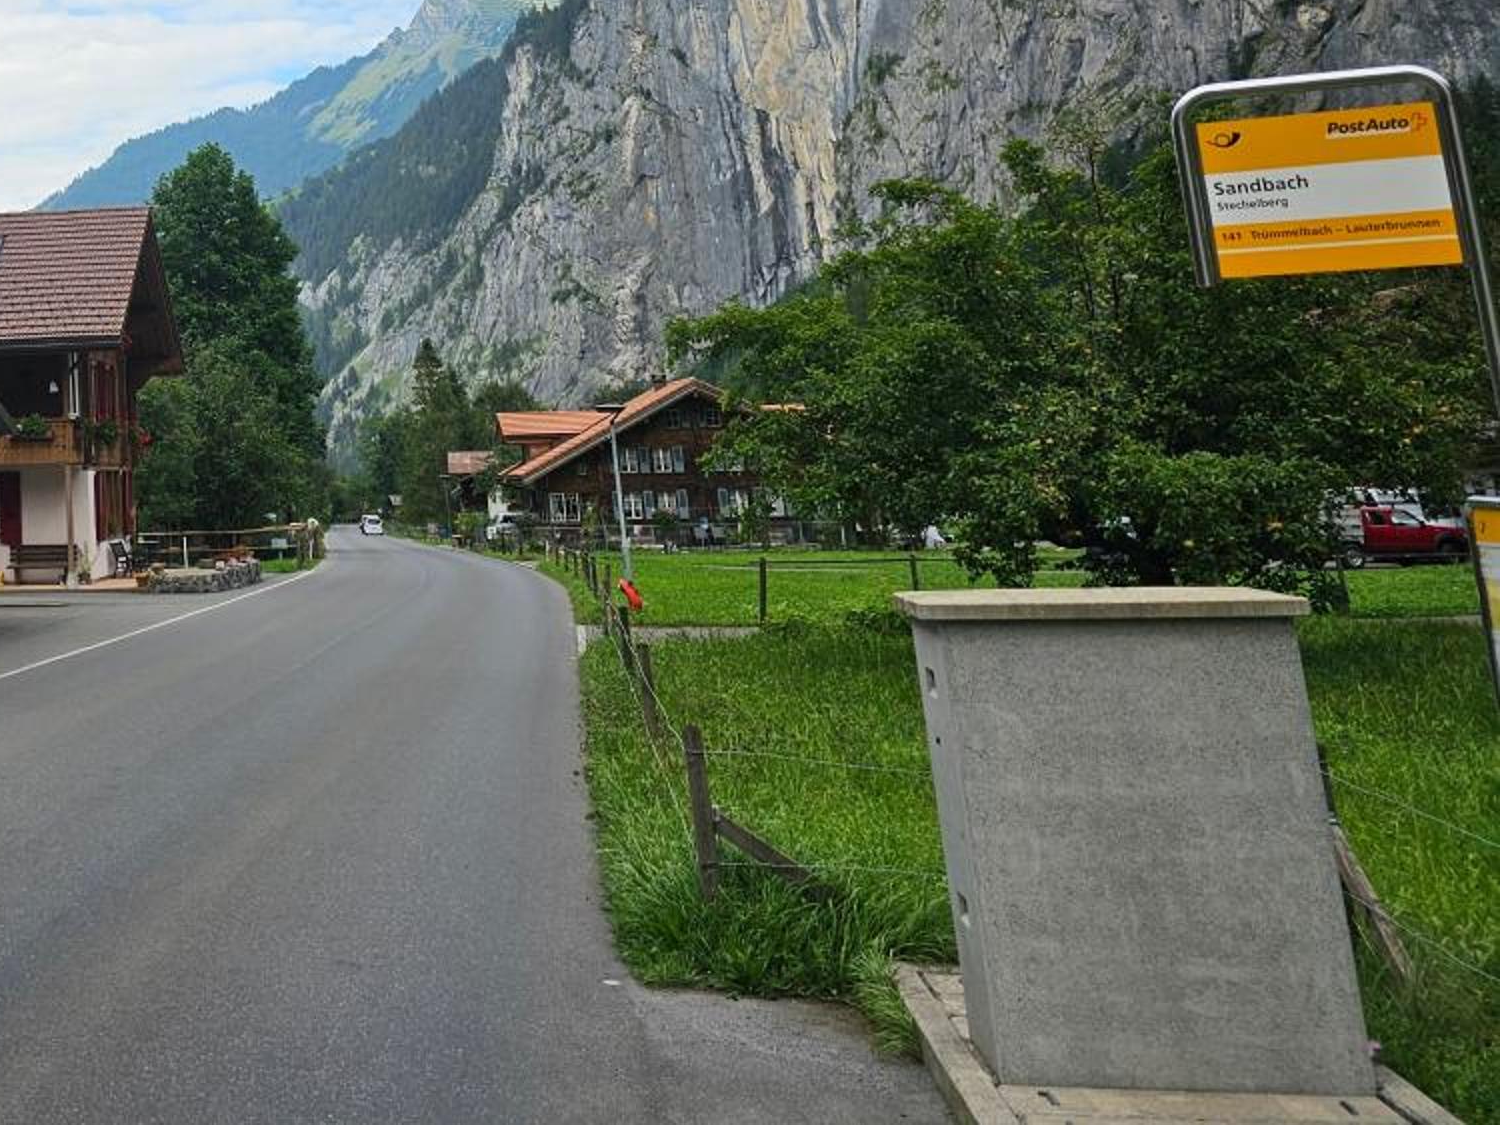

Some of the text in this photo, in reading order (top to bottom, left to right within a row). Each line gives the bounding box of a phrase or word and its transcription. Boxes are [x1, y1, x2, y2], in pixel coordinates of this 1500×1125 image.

[1327, 118, 1410, 134] PostAuto
[1213, 174, 1309, 196] Sandbach
[1217, 197, 1289, 212] Stechelberg
[1221, 231, 1242, 242] 141
